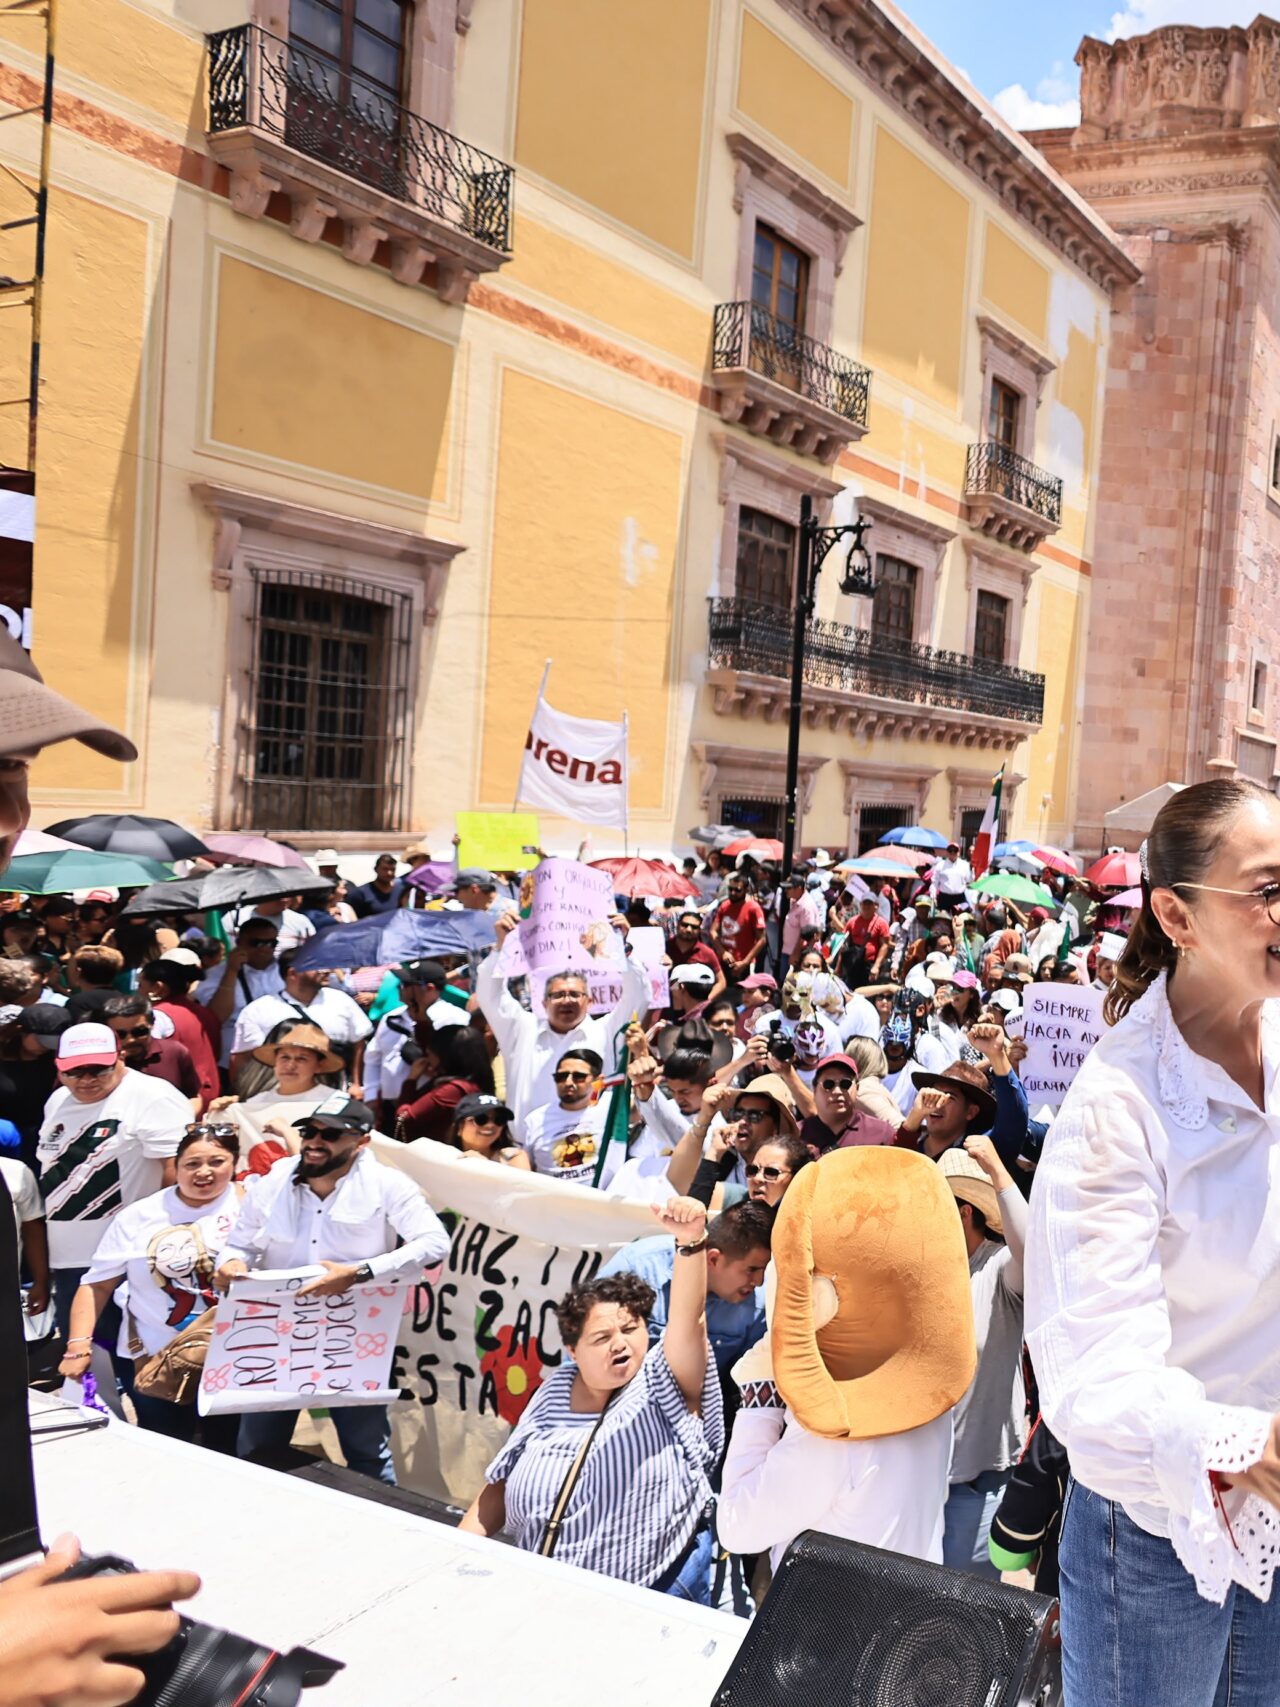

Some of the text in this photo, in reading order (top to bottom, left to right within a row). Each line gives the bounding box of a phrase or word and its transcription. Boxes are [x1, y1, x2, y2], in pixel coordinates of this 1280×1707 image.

[1033, 999, 1092, 1023] SIEMPRE
[1023, 1021, 1072, 1040] HACIA
[412, 1281, 458, 1342] DE
[232, 1355, 278, 1387] RO
